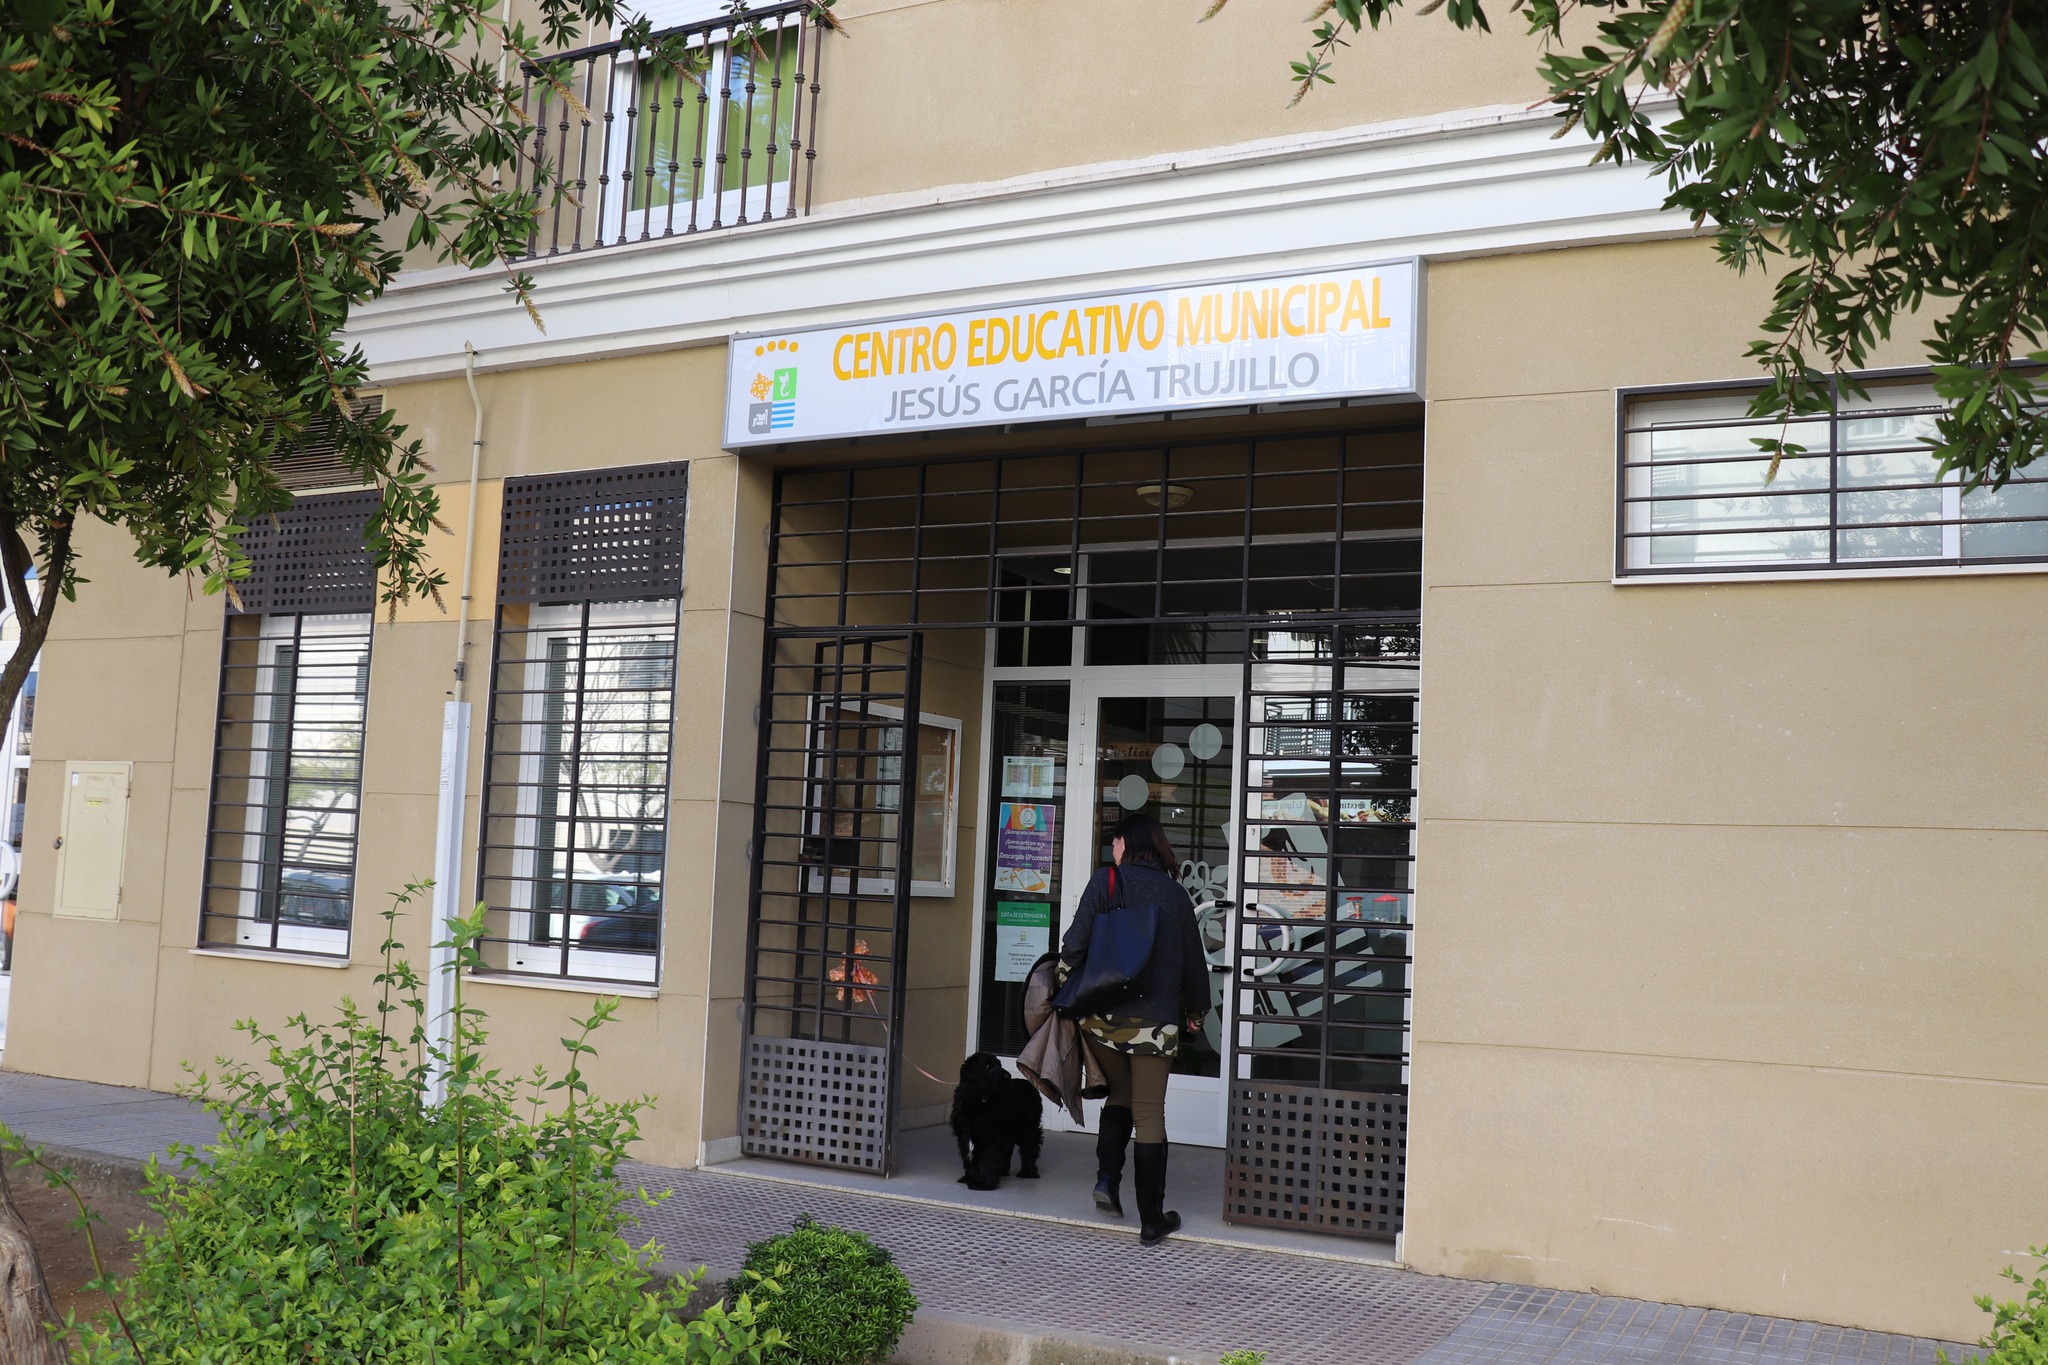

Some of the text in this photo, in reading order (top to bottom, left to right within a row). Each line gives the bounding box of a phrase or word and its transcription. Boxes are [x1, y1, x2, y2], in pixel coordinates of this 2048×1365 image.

[833, 277, 1391, 382] CENTRO EDUCATIVO MUNICIPAL
[883, 352, 1320, 423] JESÚS GARCÍA TRUJILLO
